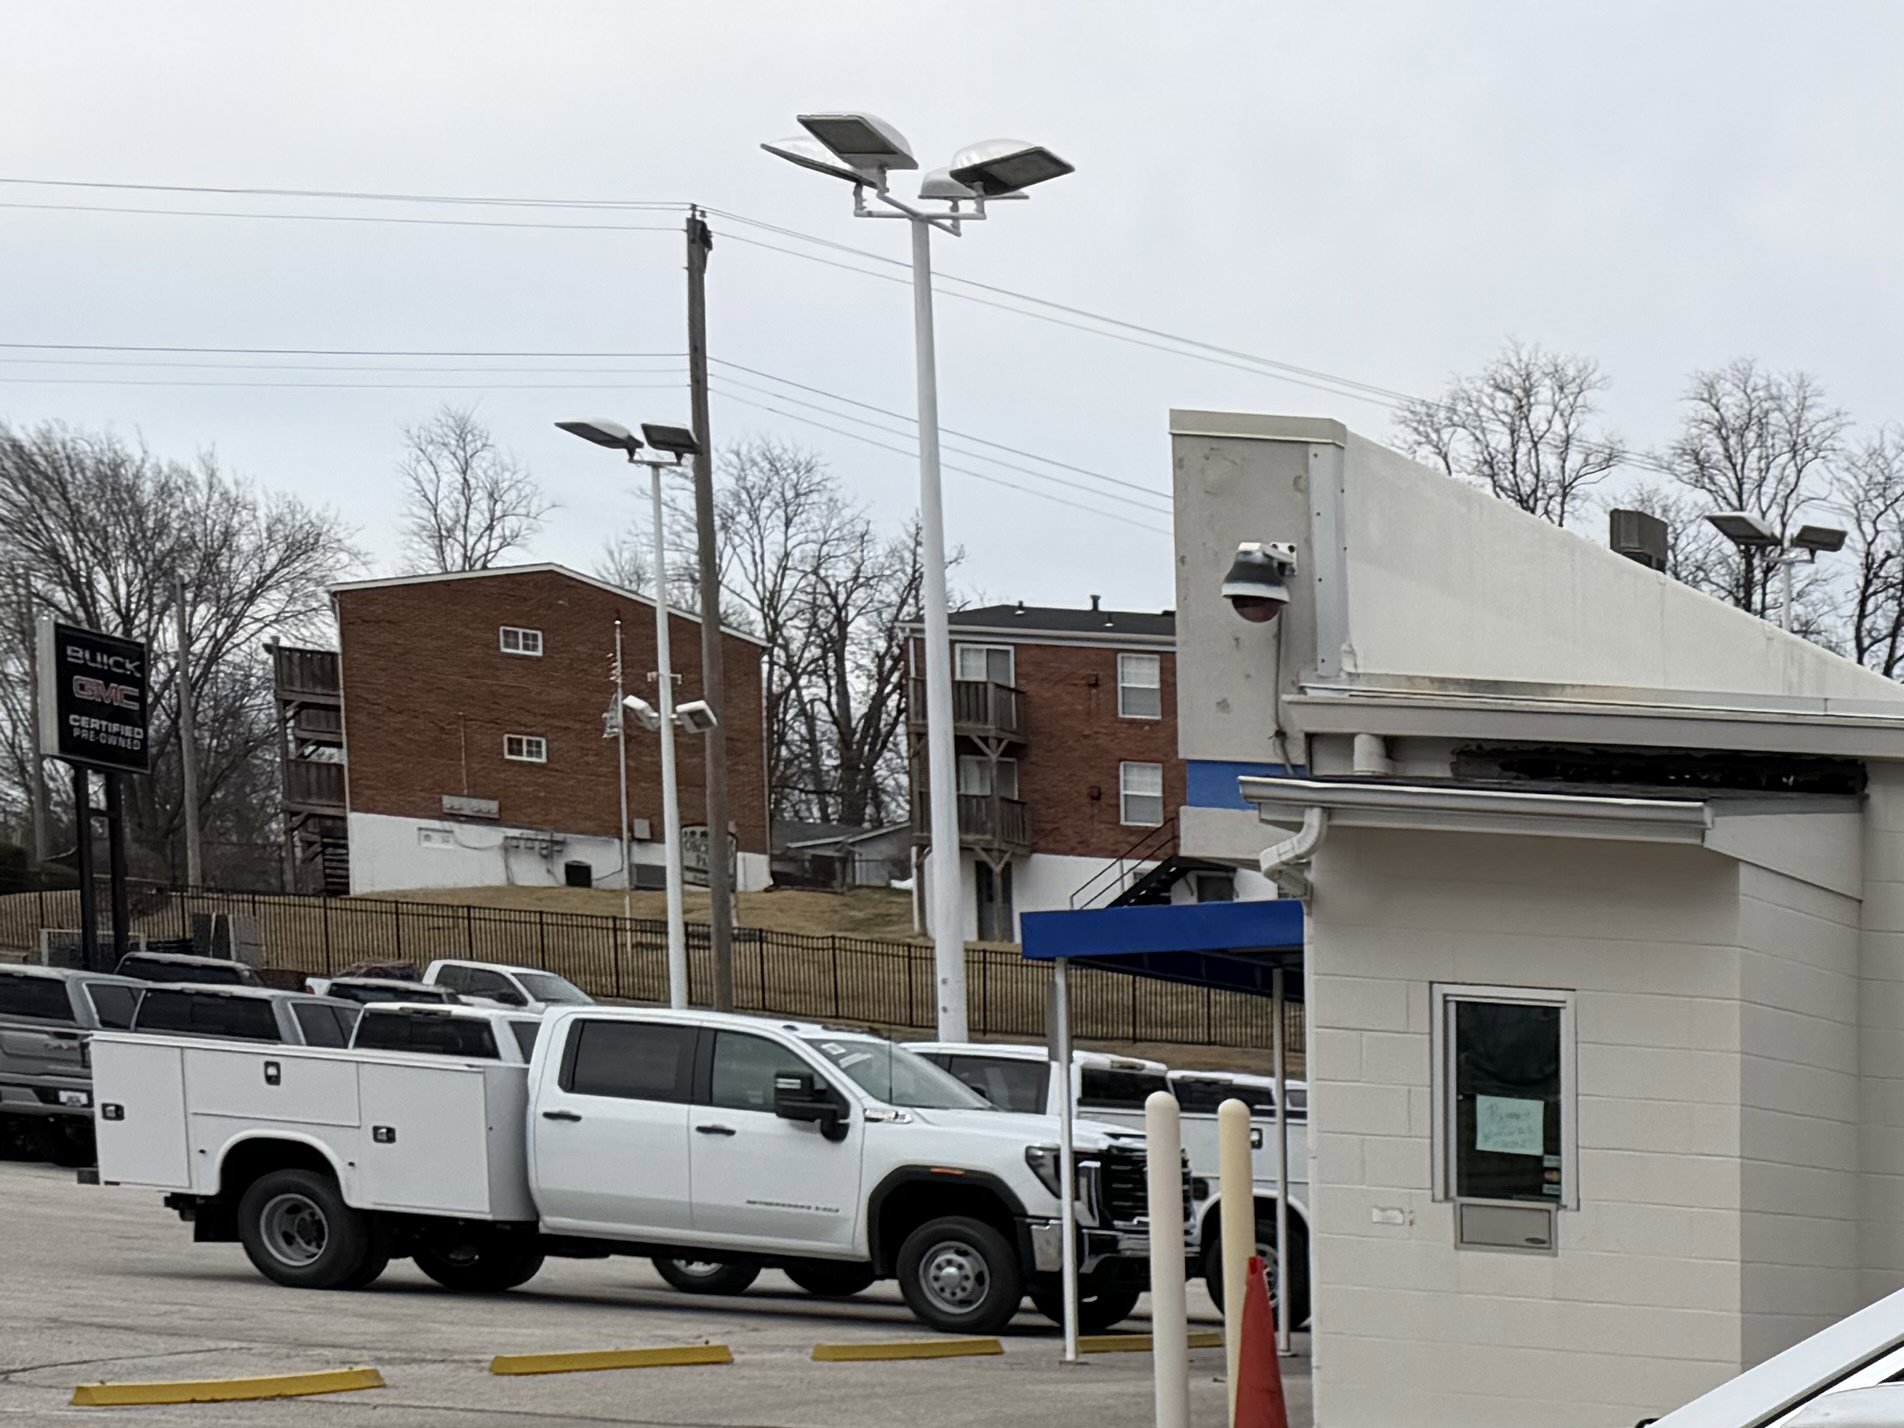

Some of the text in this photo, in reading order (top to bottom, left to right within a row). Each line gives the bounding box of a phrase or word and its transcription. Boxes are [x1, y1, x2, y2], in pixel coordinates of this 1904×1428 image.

[66, 645, 142, 678] BUICK
[72, 675, 140, 711] GMC
[69, 714, 144, 739] CERTIFIED
[73, 727, 141, 750] PRE-OWNED
